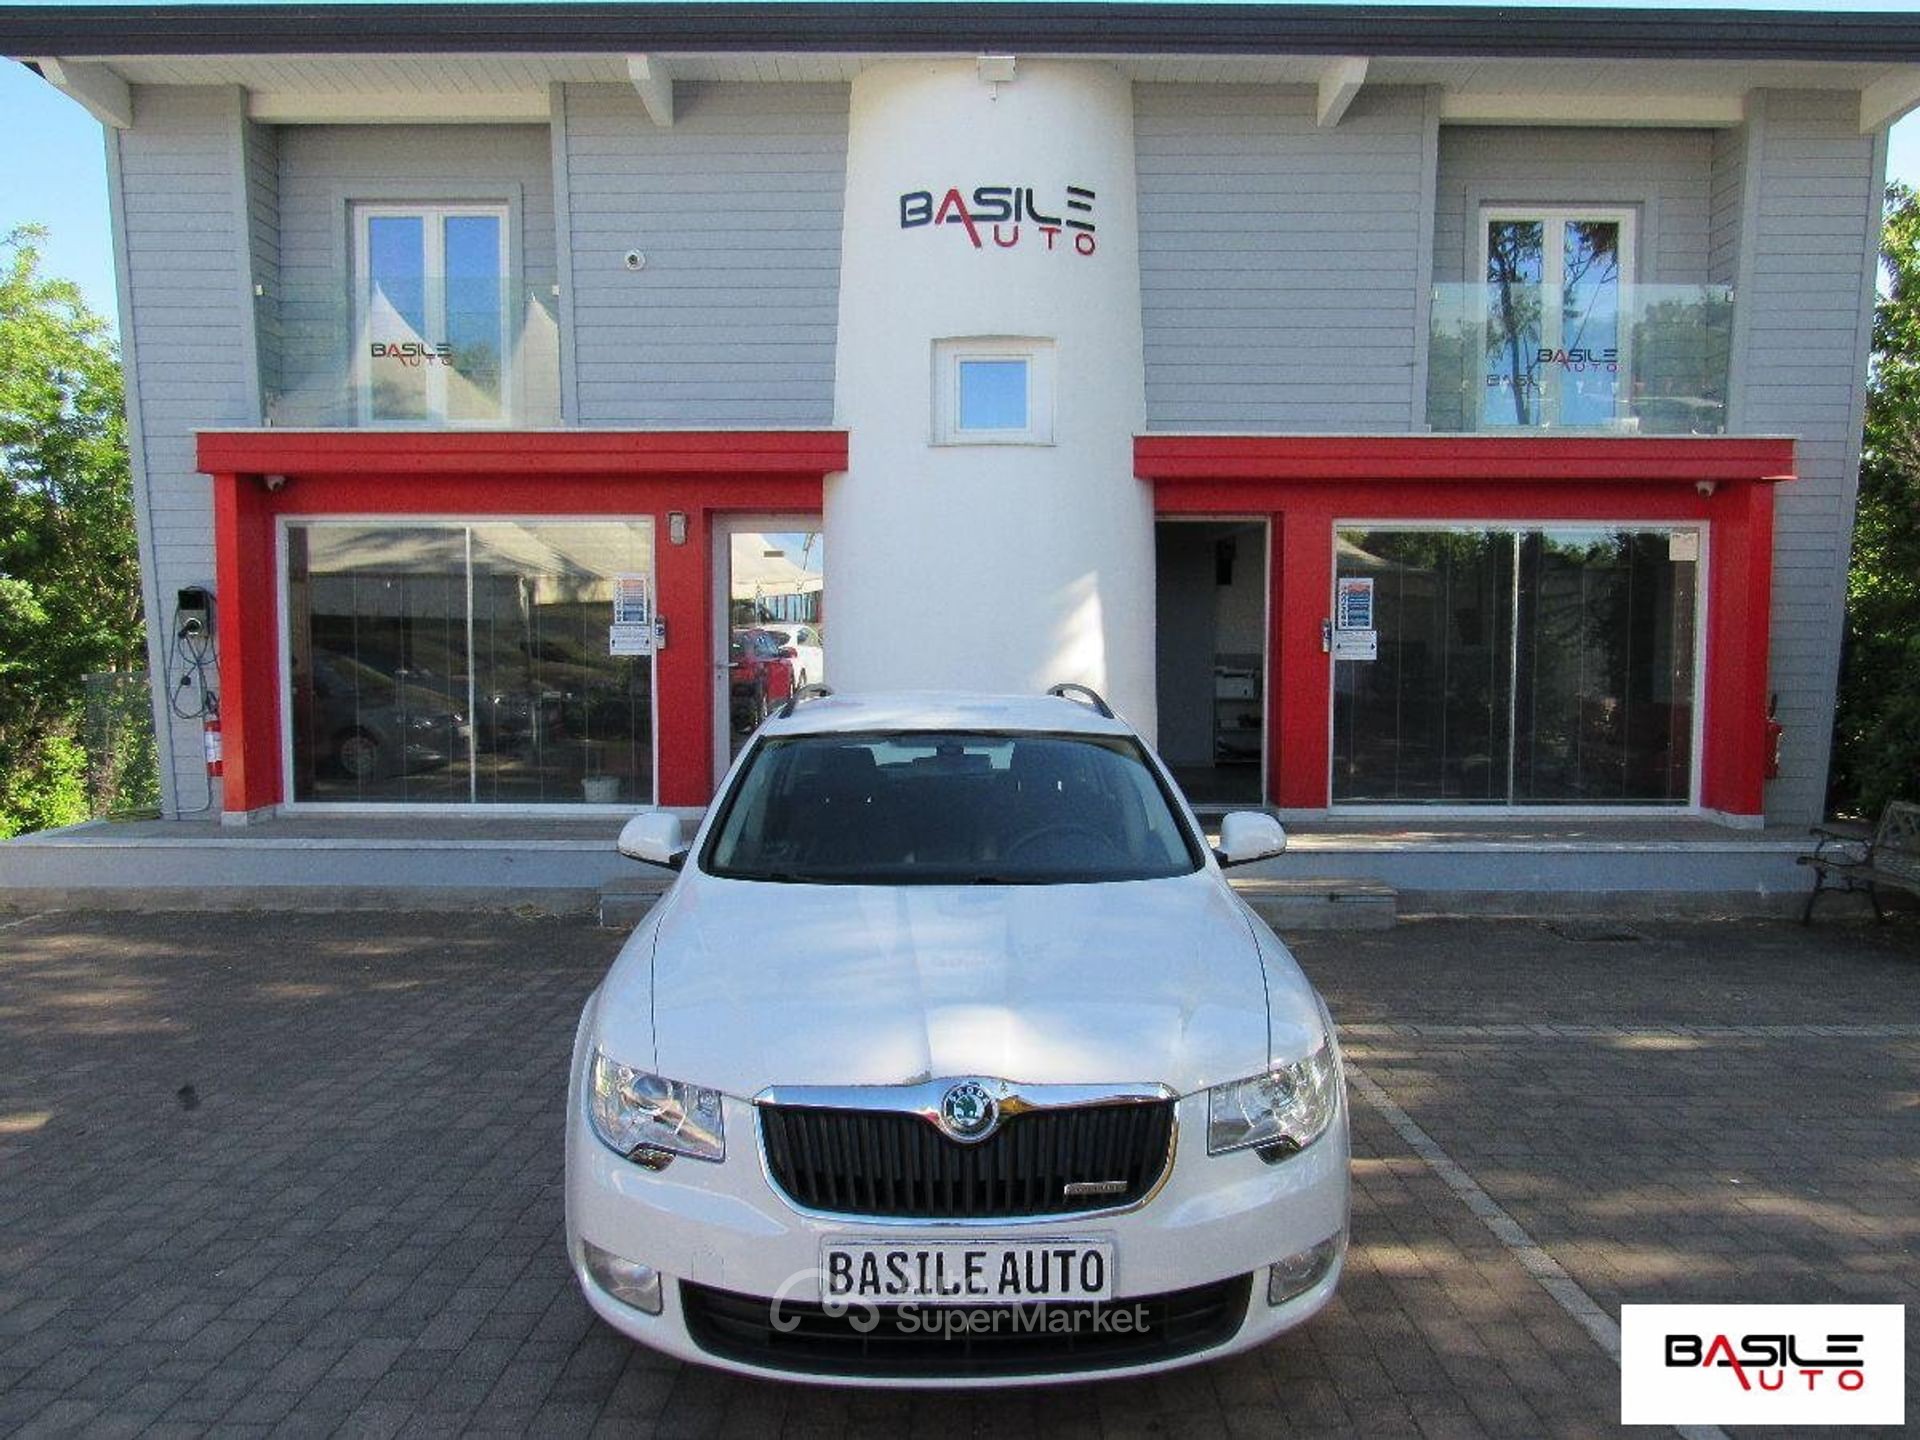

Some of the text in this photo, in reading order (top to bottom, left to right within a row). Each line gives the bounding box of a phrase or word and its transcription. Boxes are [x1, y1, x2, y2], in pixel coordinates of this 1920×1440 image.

[900, 185, 1096, 248] BASILE
[371, 343, 452, 365] BASILE
[1537, 348, 1618, 370] BASILE
[827, 1249, 1105, 1296] BASILE AUTO
